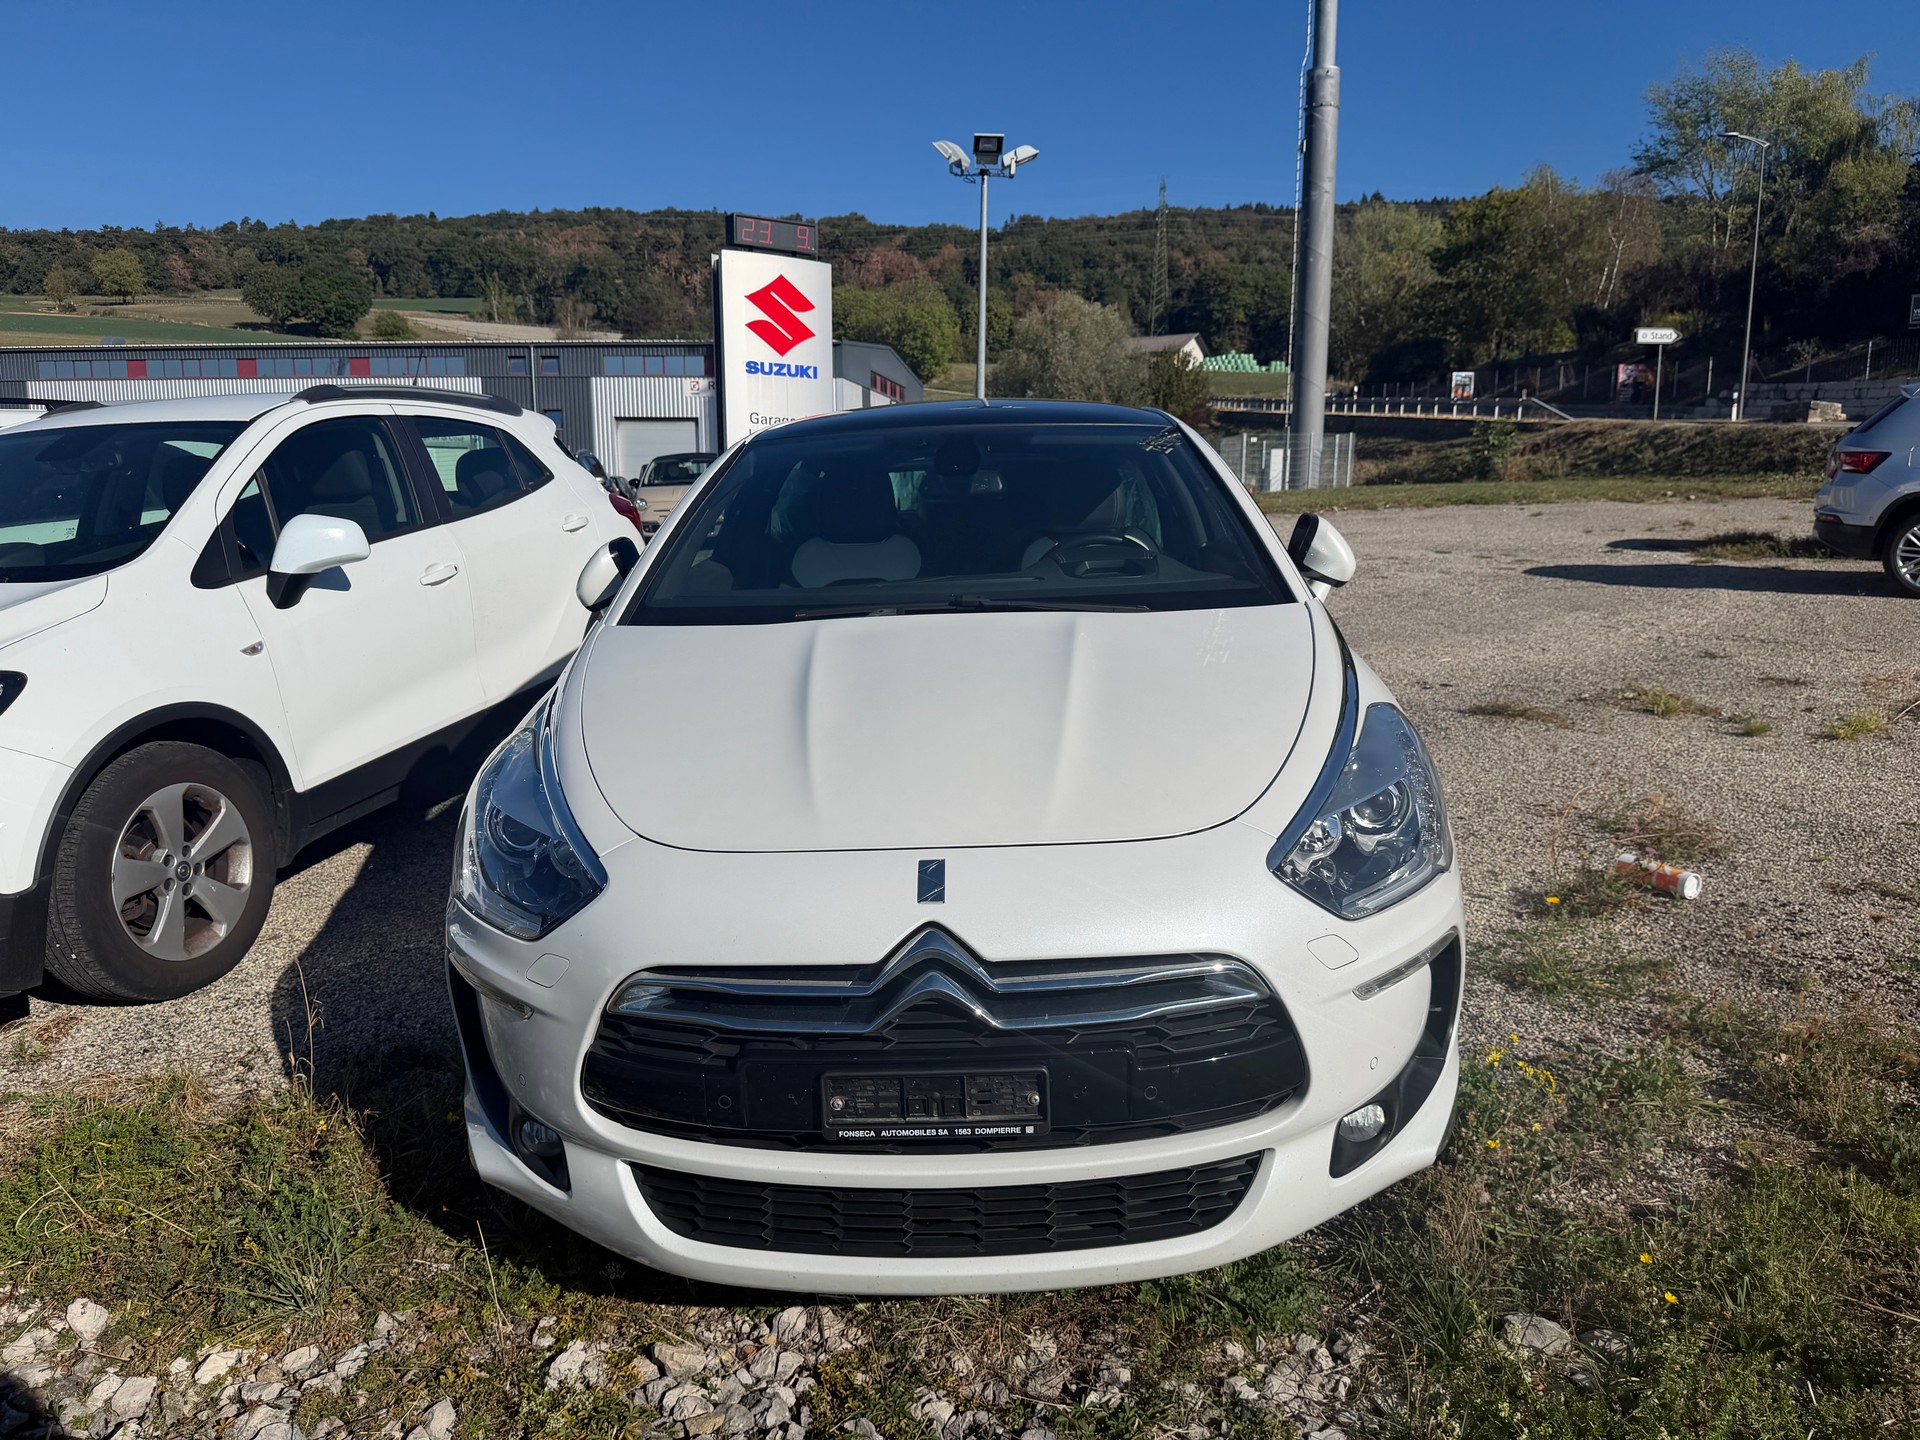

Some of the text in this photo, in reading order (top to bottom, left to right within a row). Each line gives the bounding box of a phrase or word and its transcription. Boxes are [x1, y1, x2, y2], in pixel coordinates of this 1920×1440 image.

[1651, 331, 1672, 340] Stand
[745, 360, 818, 379] SUZUKI
[838, 1130, 876, 1138] FONSECA
[880, 1128, 936, 1137] AUTOMOBILES
[937, 1128, 949, 1136] SA
[974, 1126, 1022, 1135] DOMPIERRE
